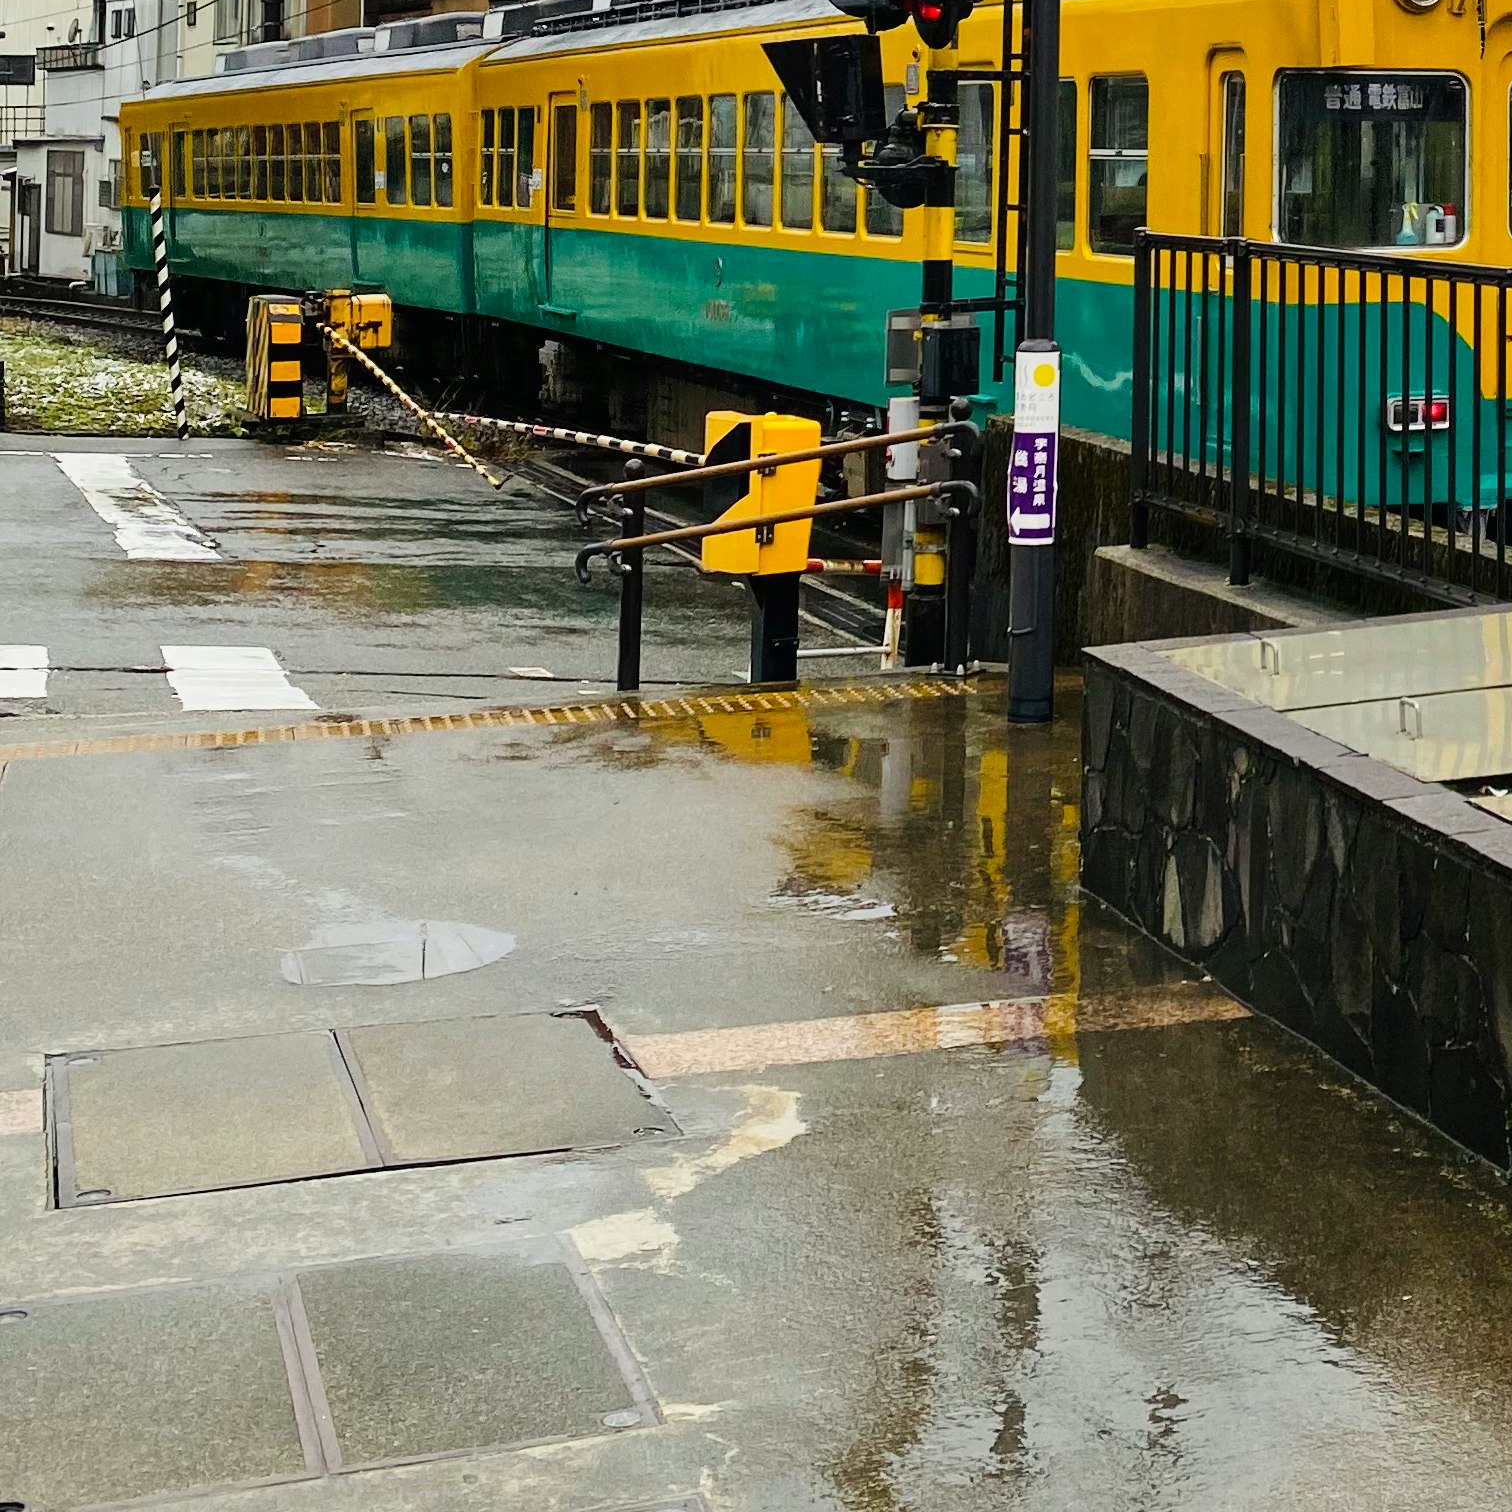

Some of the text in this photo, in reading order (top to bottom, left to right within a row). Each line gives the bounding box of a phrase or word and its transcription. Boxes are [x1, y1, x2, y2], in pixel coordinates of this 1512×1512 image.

[1033, 437, 1048, 507] 宇奈月温泉
